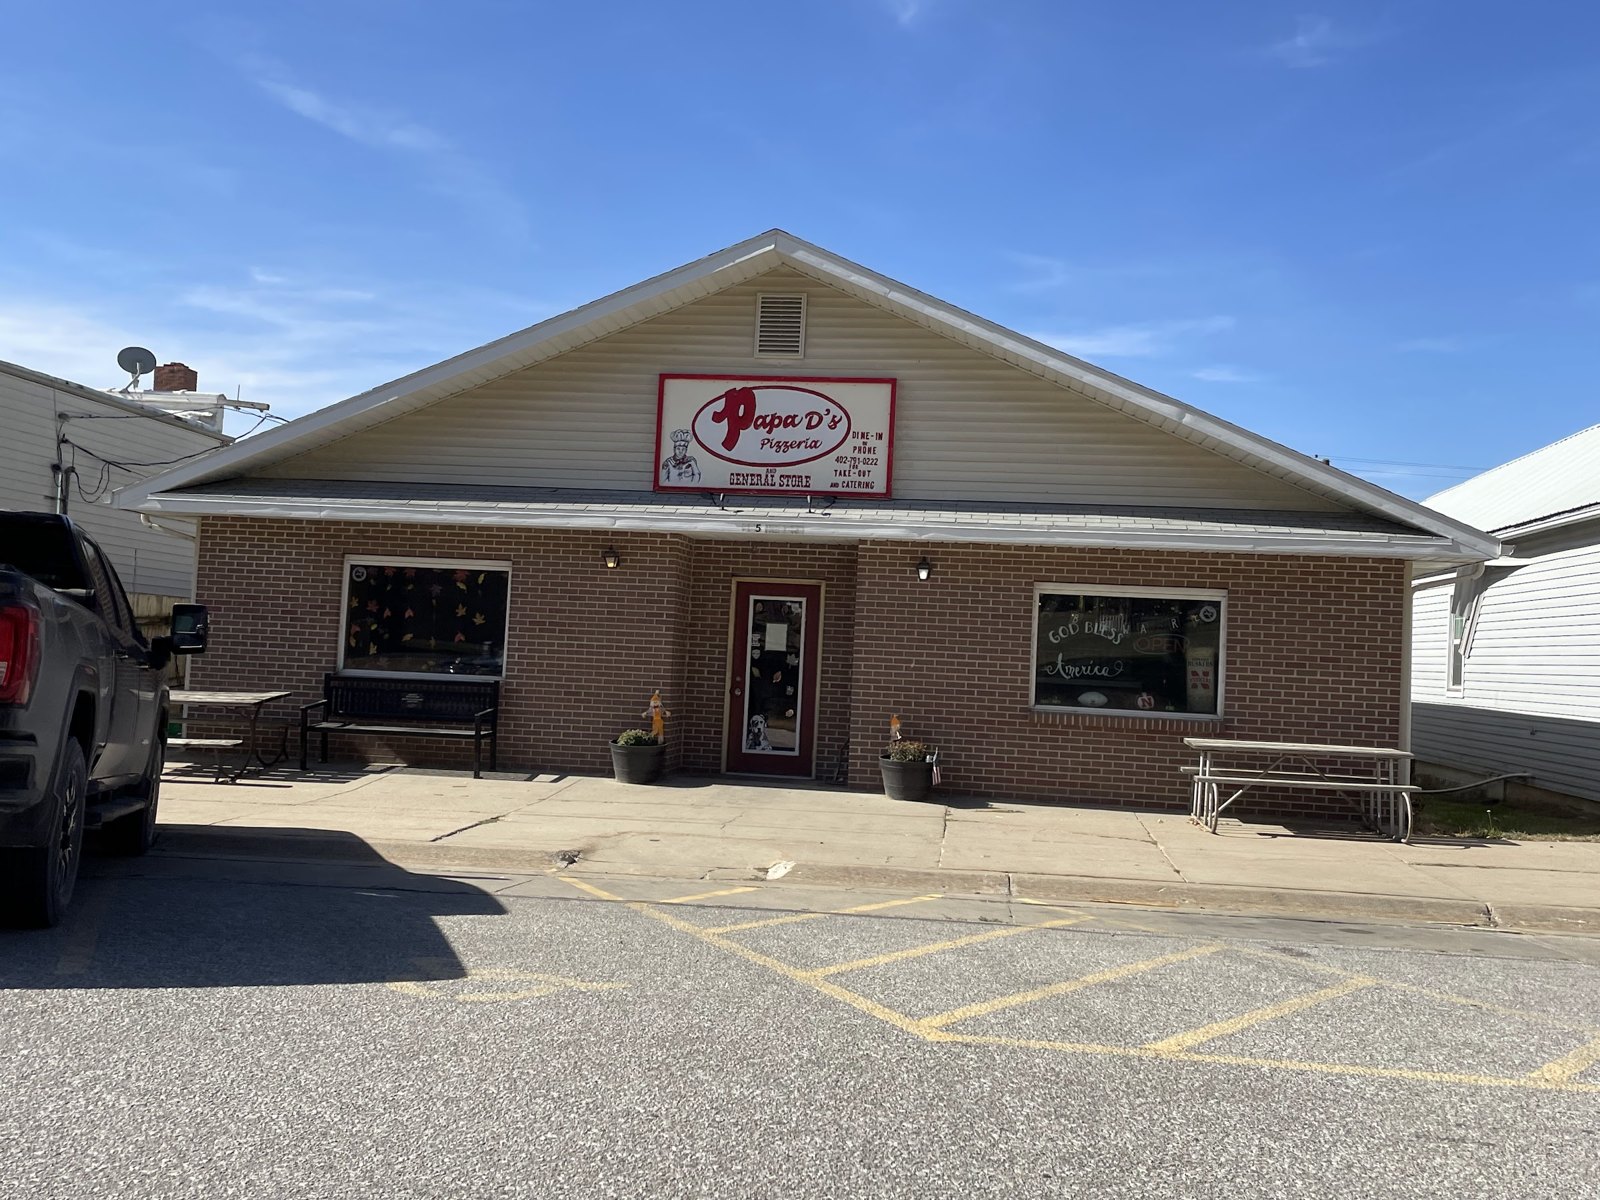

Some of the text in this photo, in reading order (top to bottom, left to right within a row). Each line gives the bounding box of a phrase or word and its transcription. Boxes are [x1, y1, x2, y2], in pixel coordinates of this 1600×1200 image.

[711, 386, 843, 452] Papa D's
[852, 431, 883, 441] DINE-IN
[760, 437, 823, 454] Pizzeria
[853, 446, 877, 455] PHONE
[835, 455, 879, 466] 402-791-0222
[729, 472, 811, 488] GENERAL STORE
[834, 469, 872, 478] TAKE-OUT
[841, 480, 875, 489] CATERING
[755, 523, 762, 533] 5
[1048, 621, 1124, 645] GOD BLESS
[1136, 637, 1185, 654] OPEN
[1041, 652, 1124, 680] America
